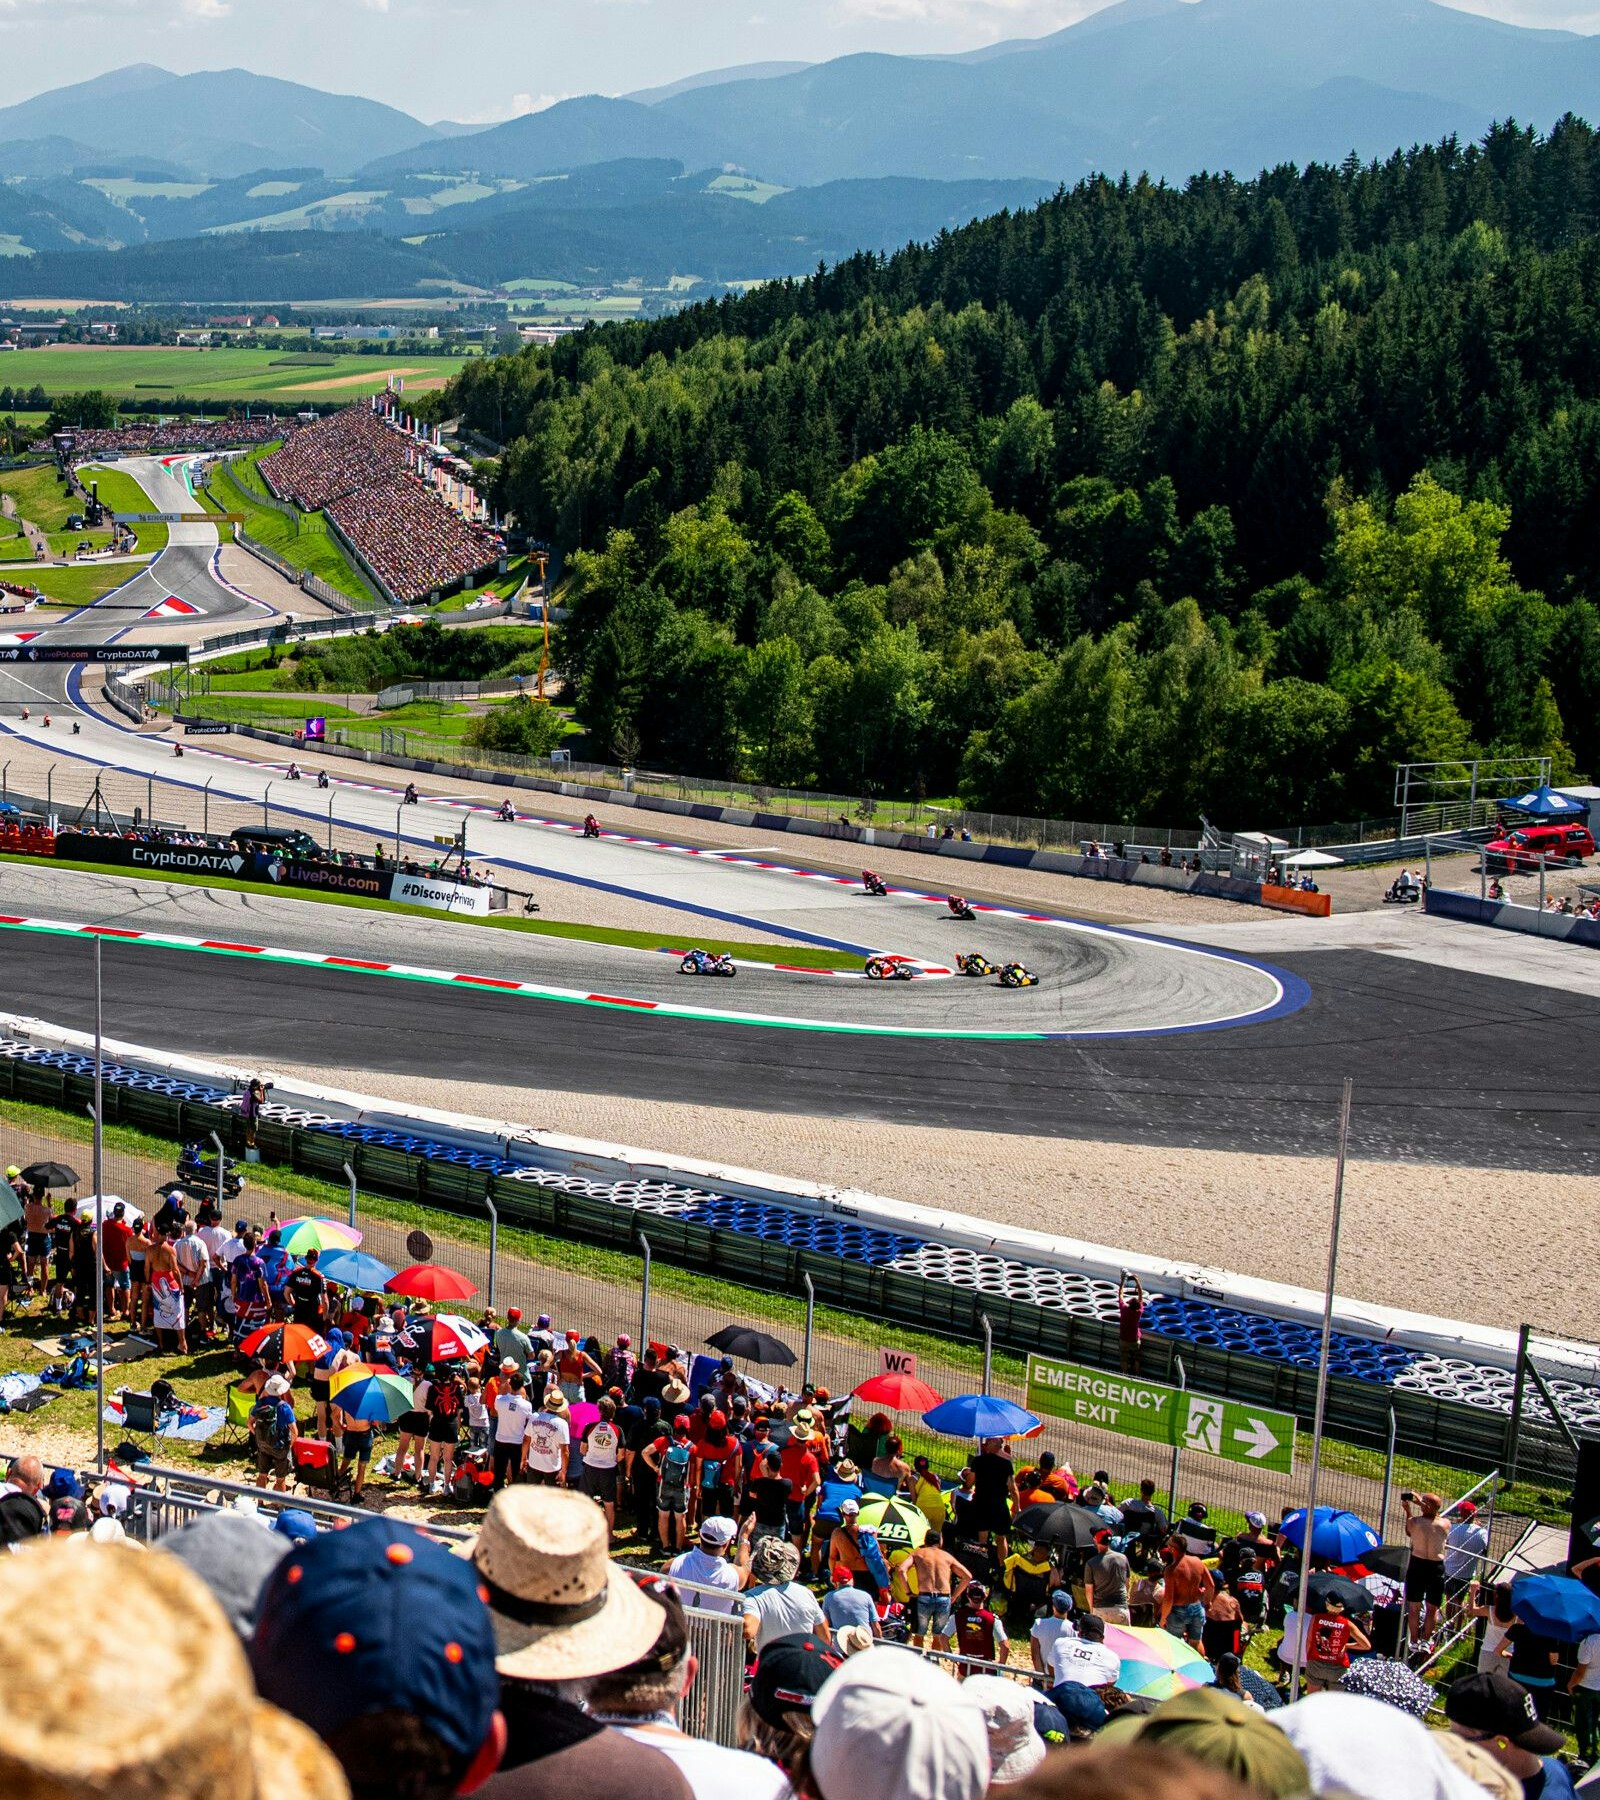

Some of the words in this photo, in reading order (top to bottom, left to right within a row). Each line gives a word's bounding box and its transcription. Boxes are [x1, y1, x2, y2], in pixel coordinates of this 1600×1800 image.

[96, 650, 153, 660] CryptoDATA
[187, 726, 223, 734] CryptoDATA
[132, 847, 231, 871] CryptoDATA
[289, 866, 380, 893] LivePot.com
[307, 1335, 327, 1357] 93
[884, 1352, 912, 1375] WC
[1033, 1363, 1167, 1413] EMERGENCY
[1074, 1399, 1120, 1426] EXIT
[877, 1523, 909, 1540] 46
[1318, 1619, 1345, 1629] DUCATI
